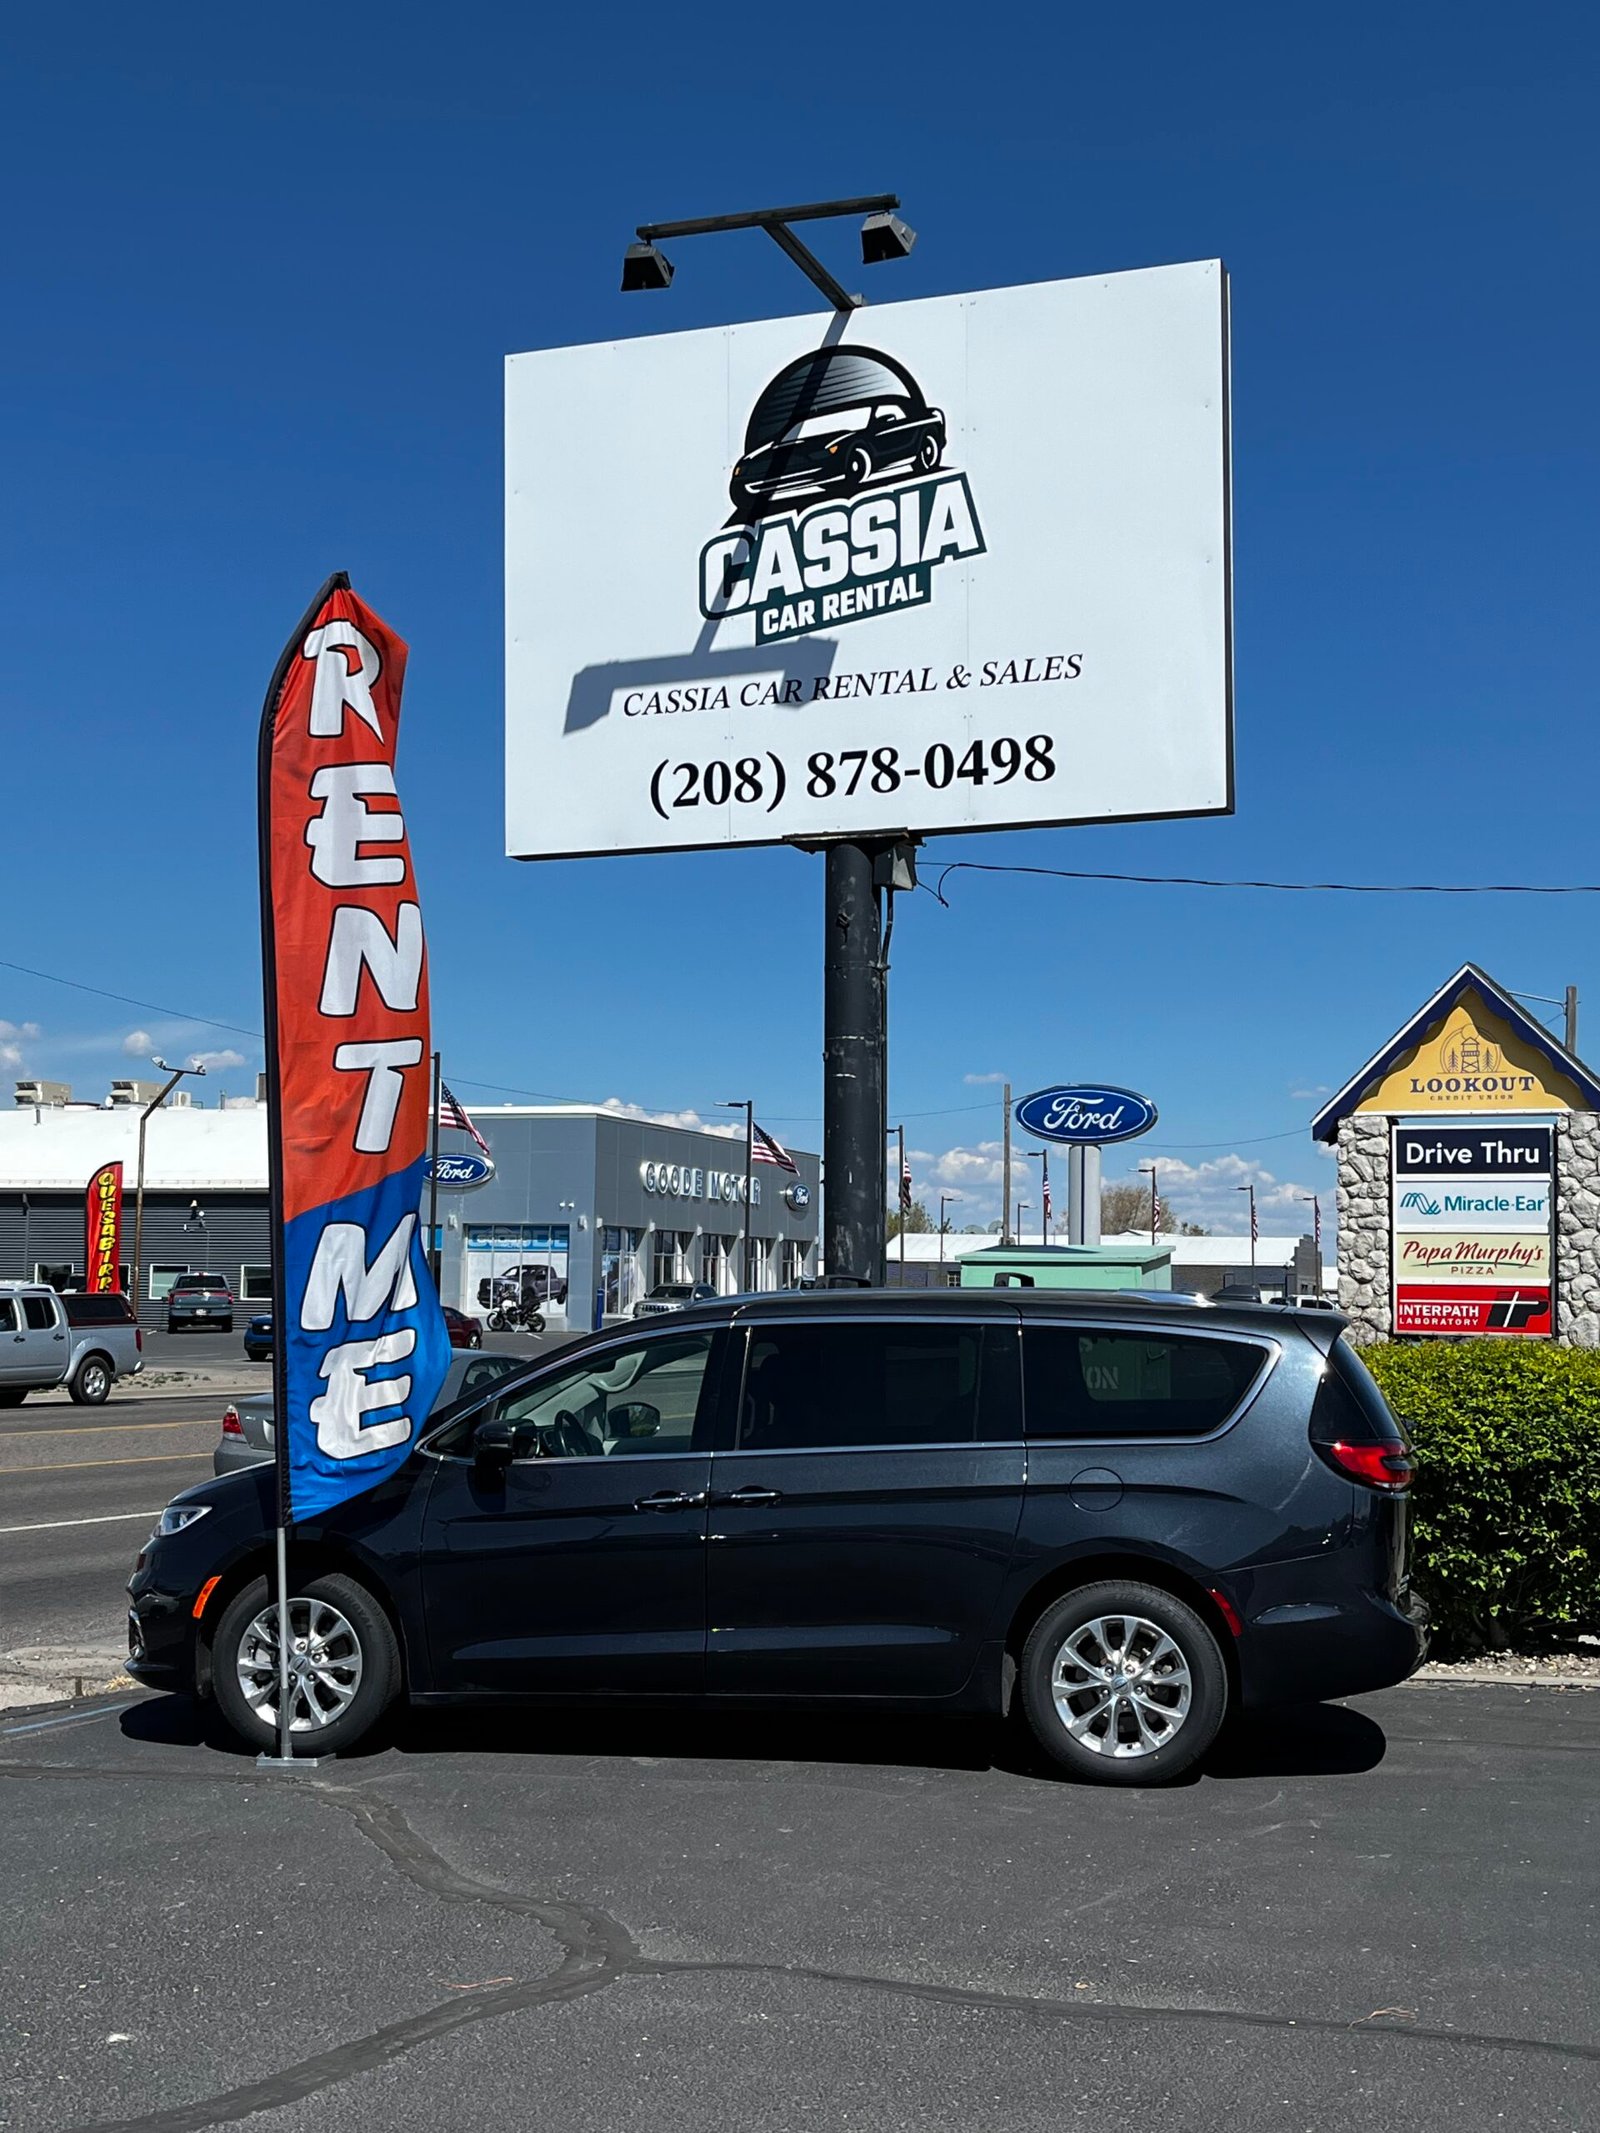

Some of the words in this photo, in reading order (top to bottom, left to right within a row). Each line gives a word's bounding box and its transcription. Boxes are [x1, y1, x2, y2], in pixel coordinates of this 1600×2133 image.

[705, 479, 980, 613] CASSIA
[762, 599, 816, 636] CAR
[822, 573, 924, 622] RENTAL
[623, 685, 729, 717] CASSIA
[740, 680, 802, 707] CAR
[812, 666, 938, 701] RENTAL
[946, 664, 972, 690] &
[979, 653, 1084, 686] SALES
[649, 750, 787, 821] (208)
[805, 733, 1057, 799] 878-0498
[302, 619, 424, 1154] RENT
[1410, 1076, 1535, 1093] LOOKOUT
[1043, 1096, 1125, 1130] Ford
[429, 1159, 475, 1179] Ford
[1406, 1142, 1473, 1164] Drive
[1480, 1140, 1540, 1164] Thru
[641, 1161, 703, 1198] GOODE
[98, 1172, 116, 1294] QUESABIRR
[1403, 1240, 1451, 1268] Papa
[1454, 1241, 1544, 1269] Murphy's
[1451, 1266, 1495, 1275] PIZZA
[1399, 1304, 1479, 1317] INTERPATH
[1399, 1318, 1479, 1326] LABORATORY
[300, 1212, 419, 1460] ME
[1082, 1365, 1119, 1390] ON
